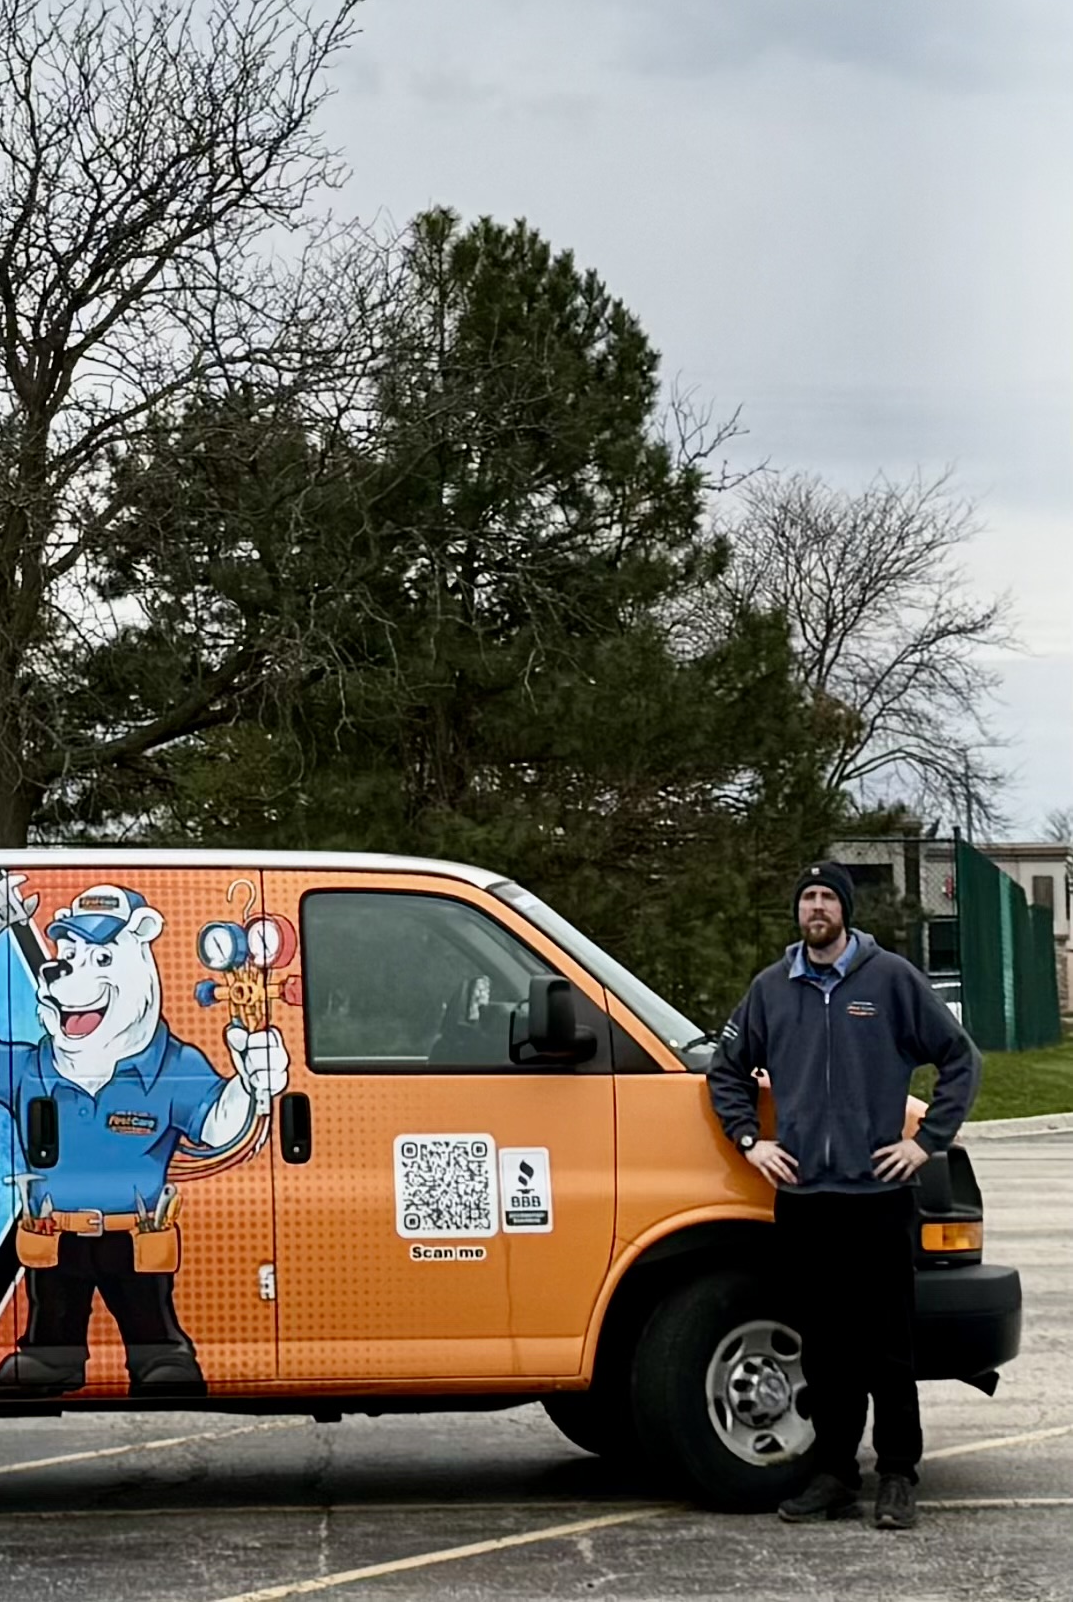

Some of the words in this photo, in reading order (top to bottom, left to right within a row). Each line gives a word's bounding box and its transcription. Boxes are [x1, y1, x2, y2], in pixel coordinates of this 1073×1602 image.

[511, 1195, 542, 1208] BBB
[412, 1246, 454, 1259] Scan
[459, 1247, 485, 1259] me
